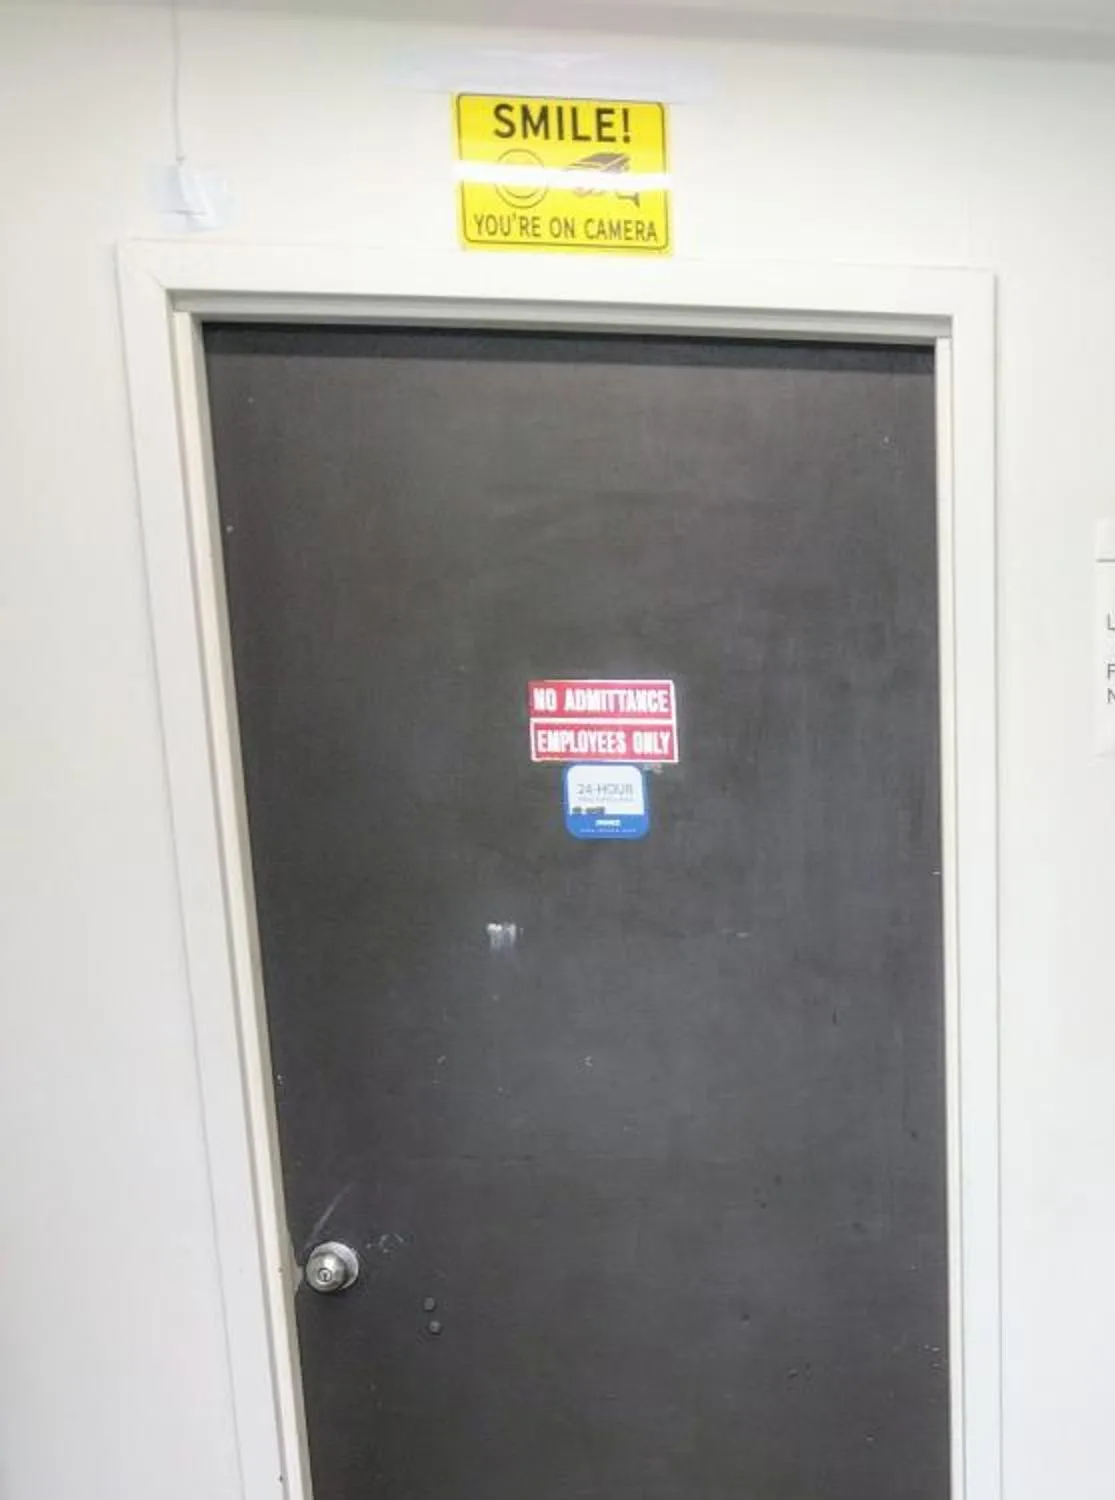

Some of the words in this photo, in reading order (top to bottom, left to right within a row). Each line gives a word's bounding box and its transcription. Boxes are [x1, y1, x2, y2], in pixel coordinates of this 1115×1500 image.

[493, 103, 631, 144] SMILE!
[474, 211, 541, 238] YOU'RE
[550, 216, 575, 239] ON
[584, 217, 658, 241] CAMERA
[533, 687, 558, 711] NO
[564, 688, 669, 713] ADMITTANCE
[536, 730, 626, 754] EMPLOYEES
[633, 731, 671, 755] ONLY
